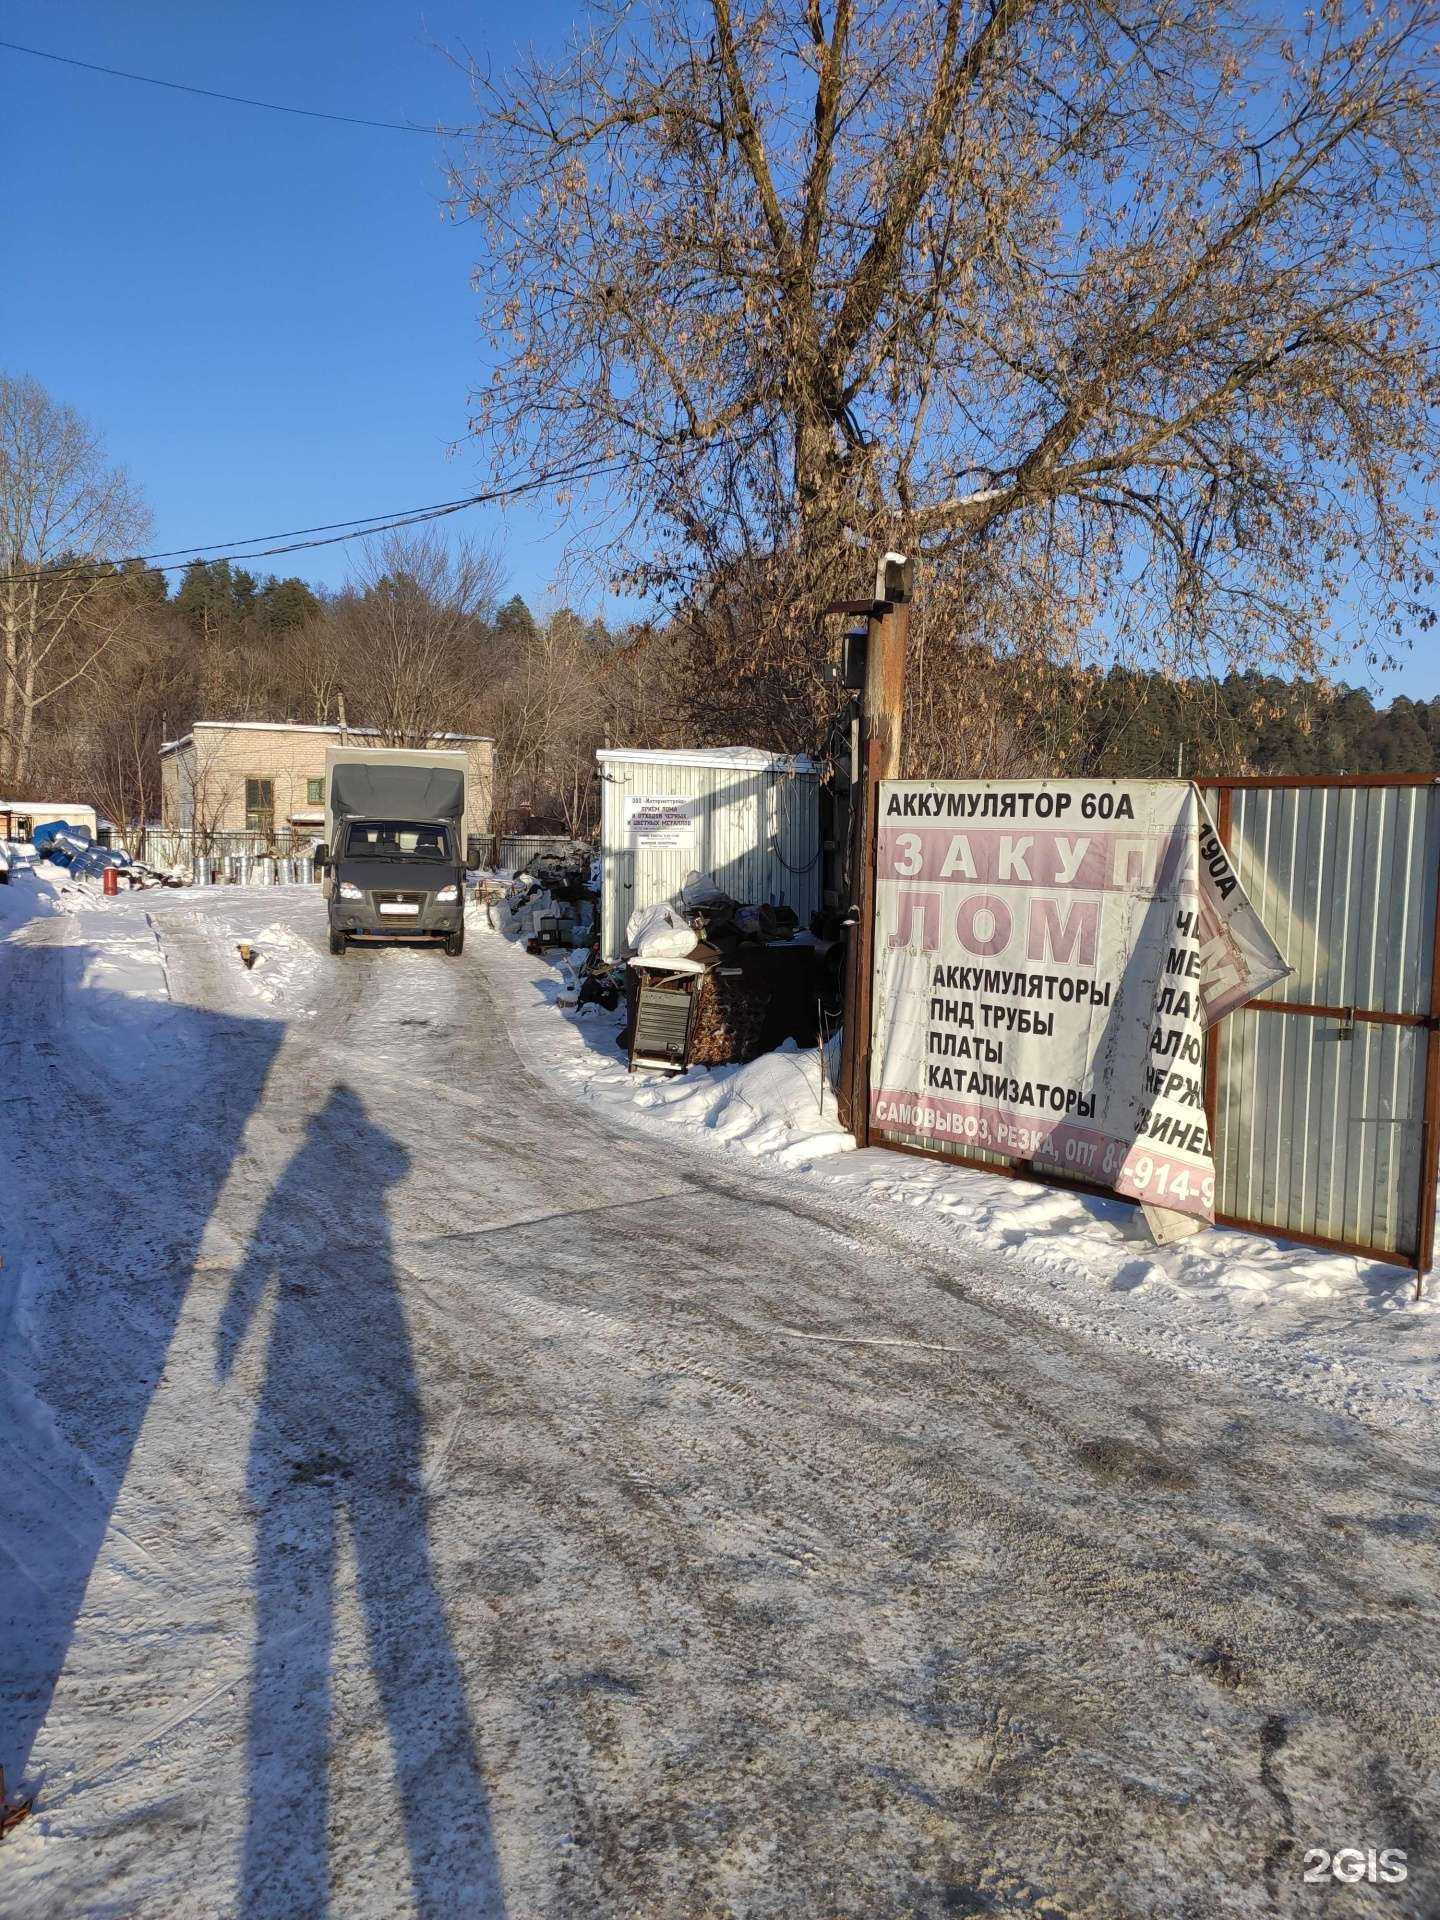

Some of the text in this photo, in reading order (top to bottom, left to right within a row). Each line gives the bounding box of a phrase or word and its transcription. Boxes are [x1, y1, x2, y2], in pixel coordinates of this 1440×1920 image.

[886, 791, 1134, 820] АККУМУЛЯТОР 60А
[887, 890, 1101, 967] ЛОМ
[932, 964, 1112, 1007] АККУМУЛЯТОРЫ
[930, 997, 1055, 1037] ПНД ТРУБЫ
[928, 1031, 1004, 1064] ПЛАТЫ
[928, 1065, 1097, 1119] КАТАЛИЗАТОРЫ
[875, 1099, 992, 1145] САМОВЫВОЗ,
[997, 1122, 1060, 1162] РЕЗКА,
[1065, 1140, 1100, 1166] ОПТ
